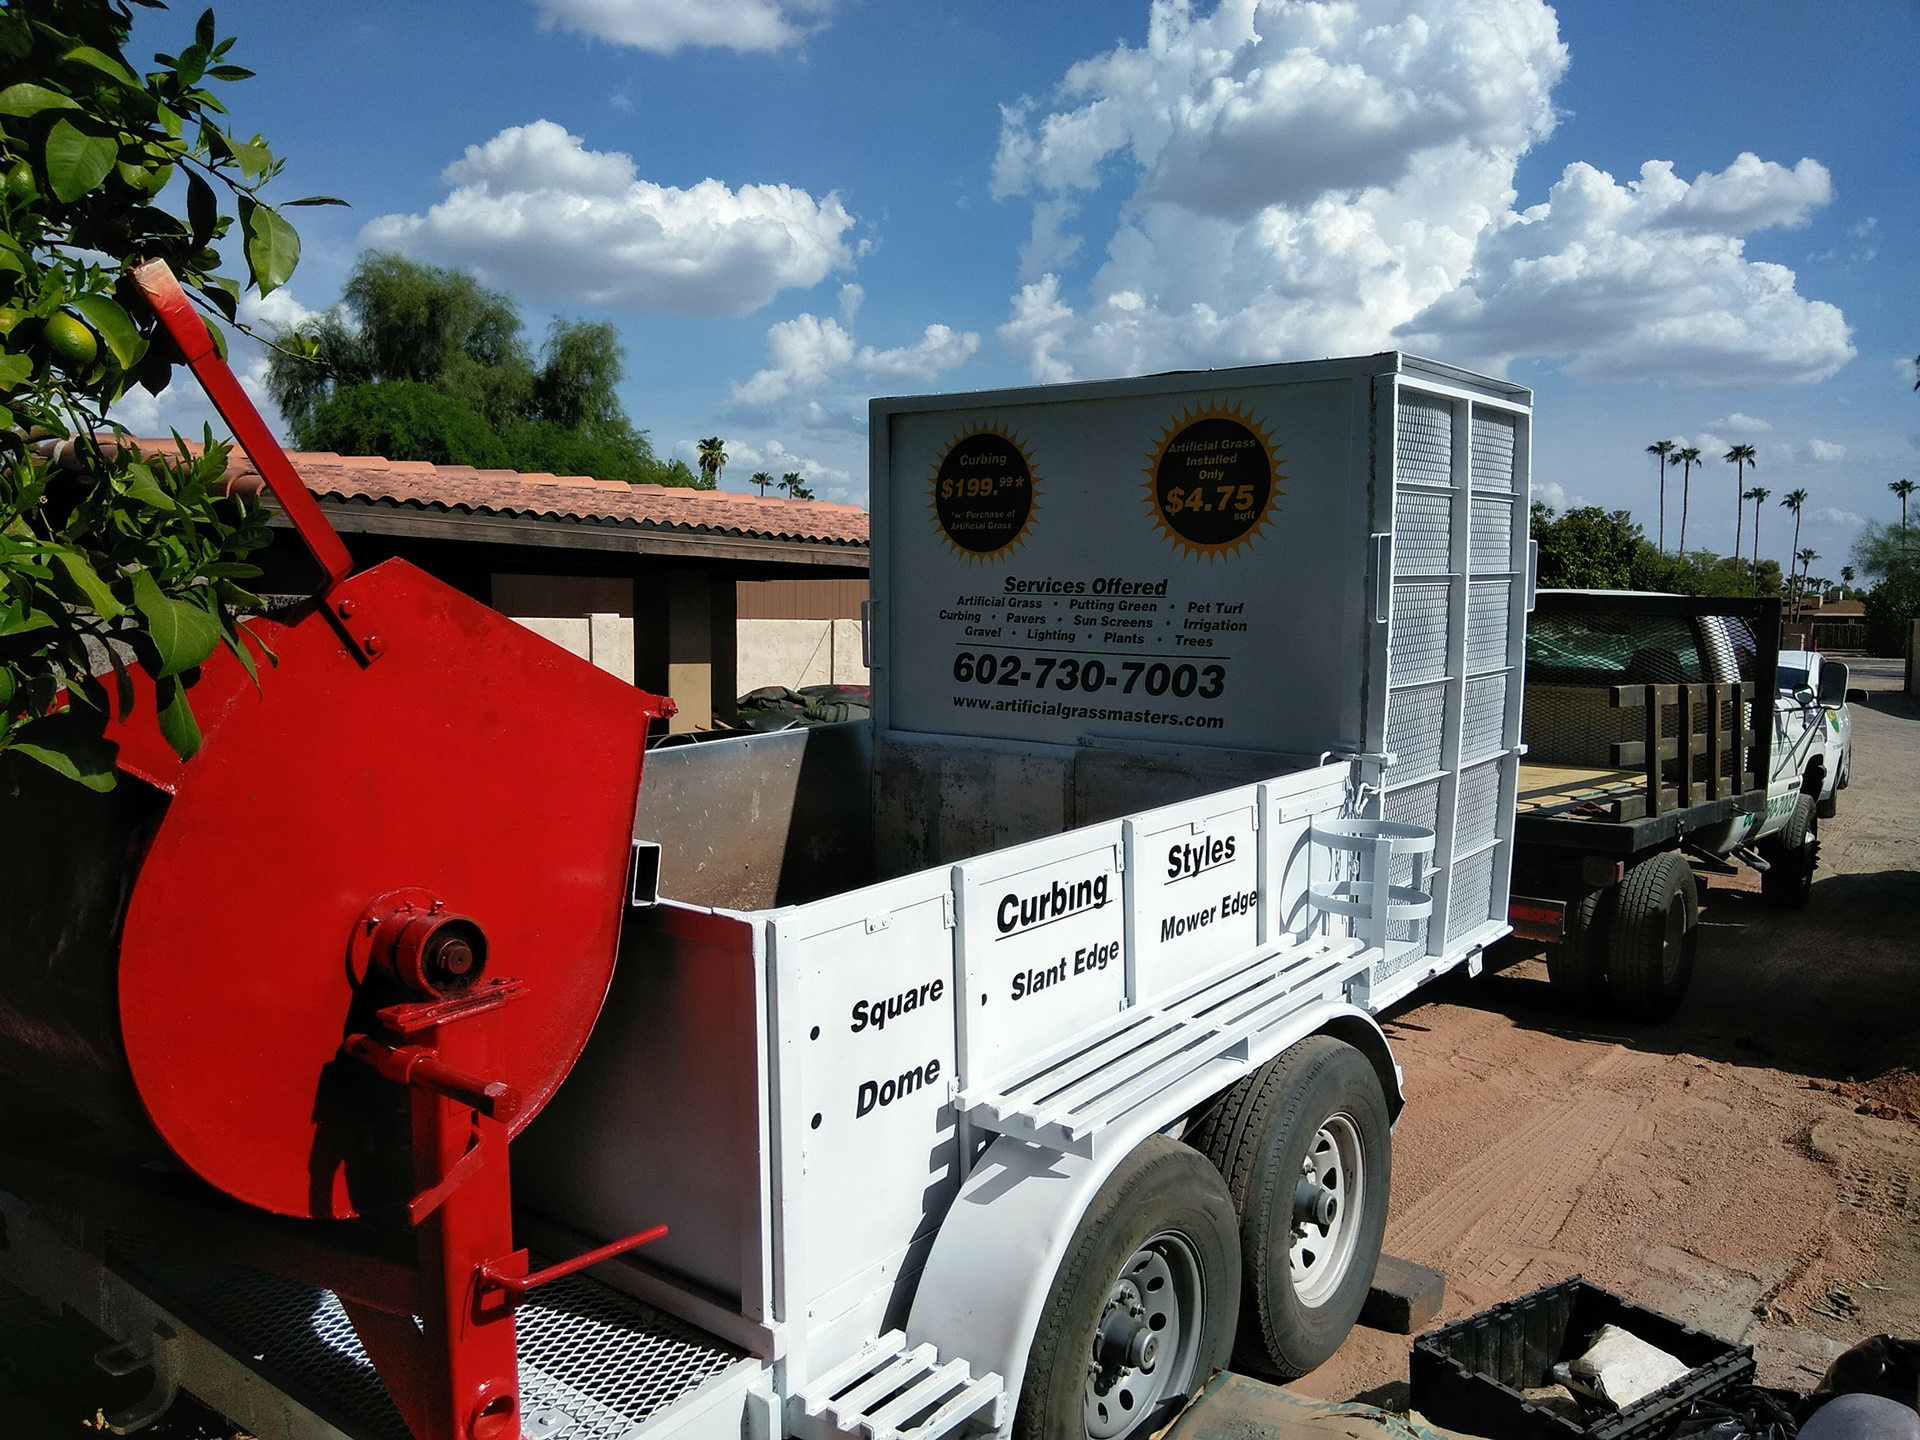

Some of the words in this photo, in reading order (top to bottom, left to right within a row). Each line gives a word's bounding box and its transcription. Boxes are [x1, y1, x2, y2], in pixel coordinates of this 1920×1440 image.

[1168, 441, 1218, 453] Artificial
[1221, 439, 1256, 450] Grass
[960, 453, 1007, 466] Curbing
[1186, 453, 1238, 466] Installed
[1198, 469, 1225, 480] Only
[1165, 484, 1254, 516] $4.75
[966, 510, 1004, 519] Purchase
[1007, 510, 1016, 518] of
[1234, 510, 1256, 521] sqft
[950, 521, 986, 530] Artificial
[987, 521, 1012, 530] Grass
[1004, 576, 1086, 594] Services
[1092, 577, 1168, 596] Offered
[956, 596, 1005, 607] Artificial
[1008, 597, 1042, 609] Grass
[1069, 599, 1114, 613] Putting
[1118, 600, 1157, 612] Green
[1187, 601, 1211, 613] Pet
[1215, 602, 1245, 614] Turf
[939, 610, 981, 623] Curbing
[1006, 612, 1046, 624] Pavers
[1073, 615, 1097, 626] Sun
[1101, 615, 1153, 628] Screens
[1183, 618, 1247, 633] Irrigation
[965, 626, 1002, 637] Gravel
[1027, 629, 1076, 643] Lighting
[1103, 632, 1145, 644] Plants
[1175, 635, 1214, 647] Trees
[953, 651, 1226, 699] 602-730-7003
[953, 696, 1225, 729] www.artificialgrassmasters.com
[996, 872, 1109, 934] Curbing
[1167, 832, 1236, 880] Styles
[1160, 904, 1217, 944] Mower
[1221, 887, 1258, 920] Edge
[1011, 955, 1067, 1002] Slant
[1074, 938, 1120, 977] Edge
[851, 975, 945, 1035] Square
[856, 1058, 941, 1119] Dome
